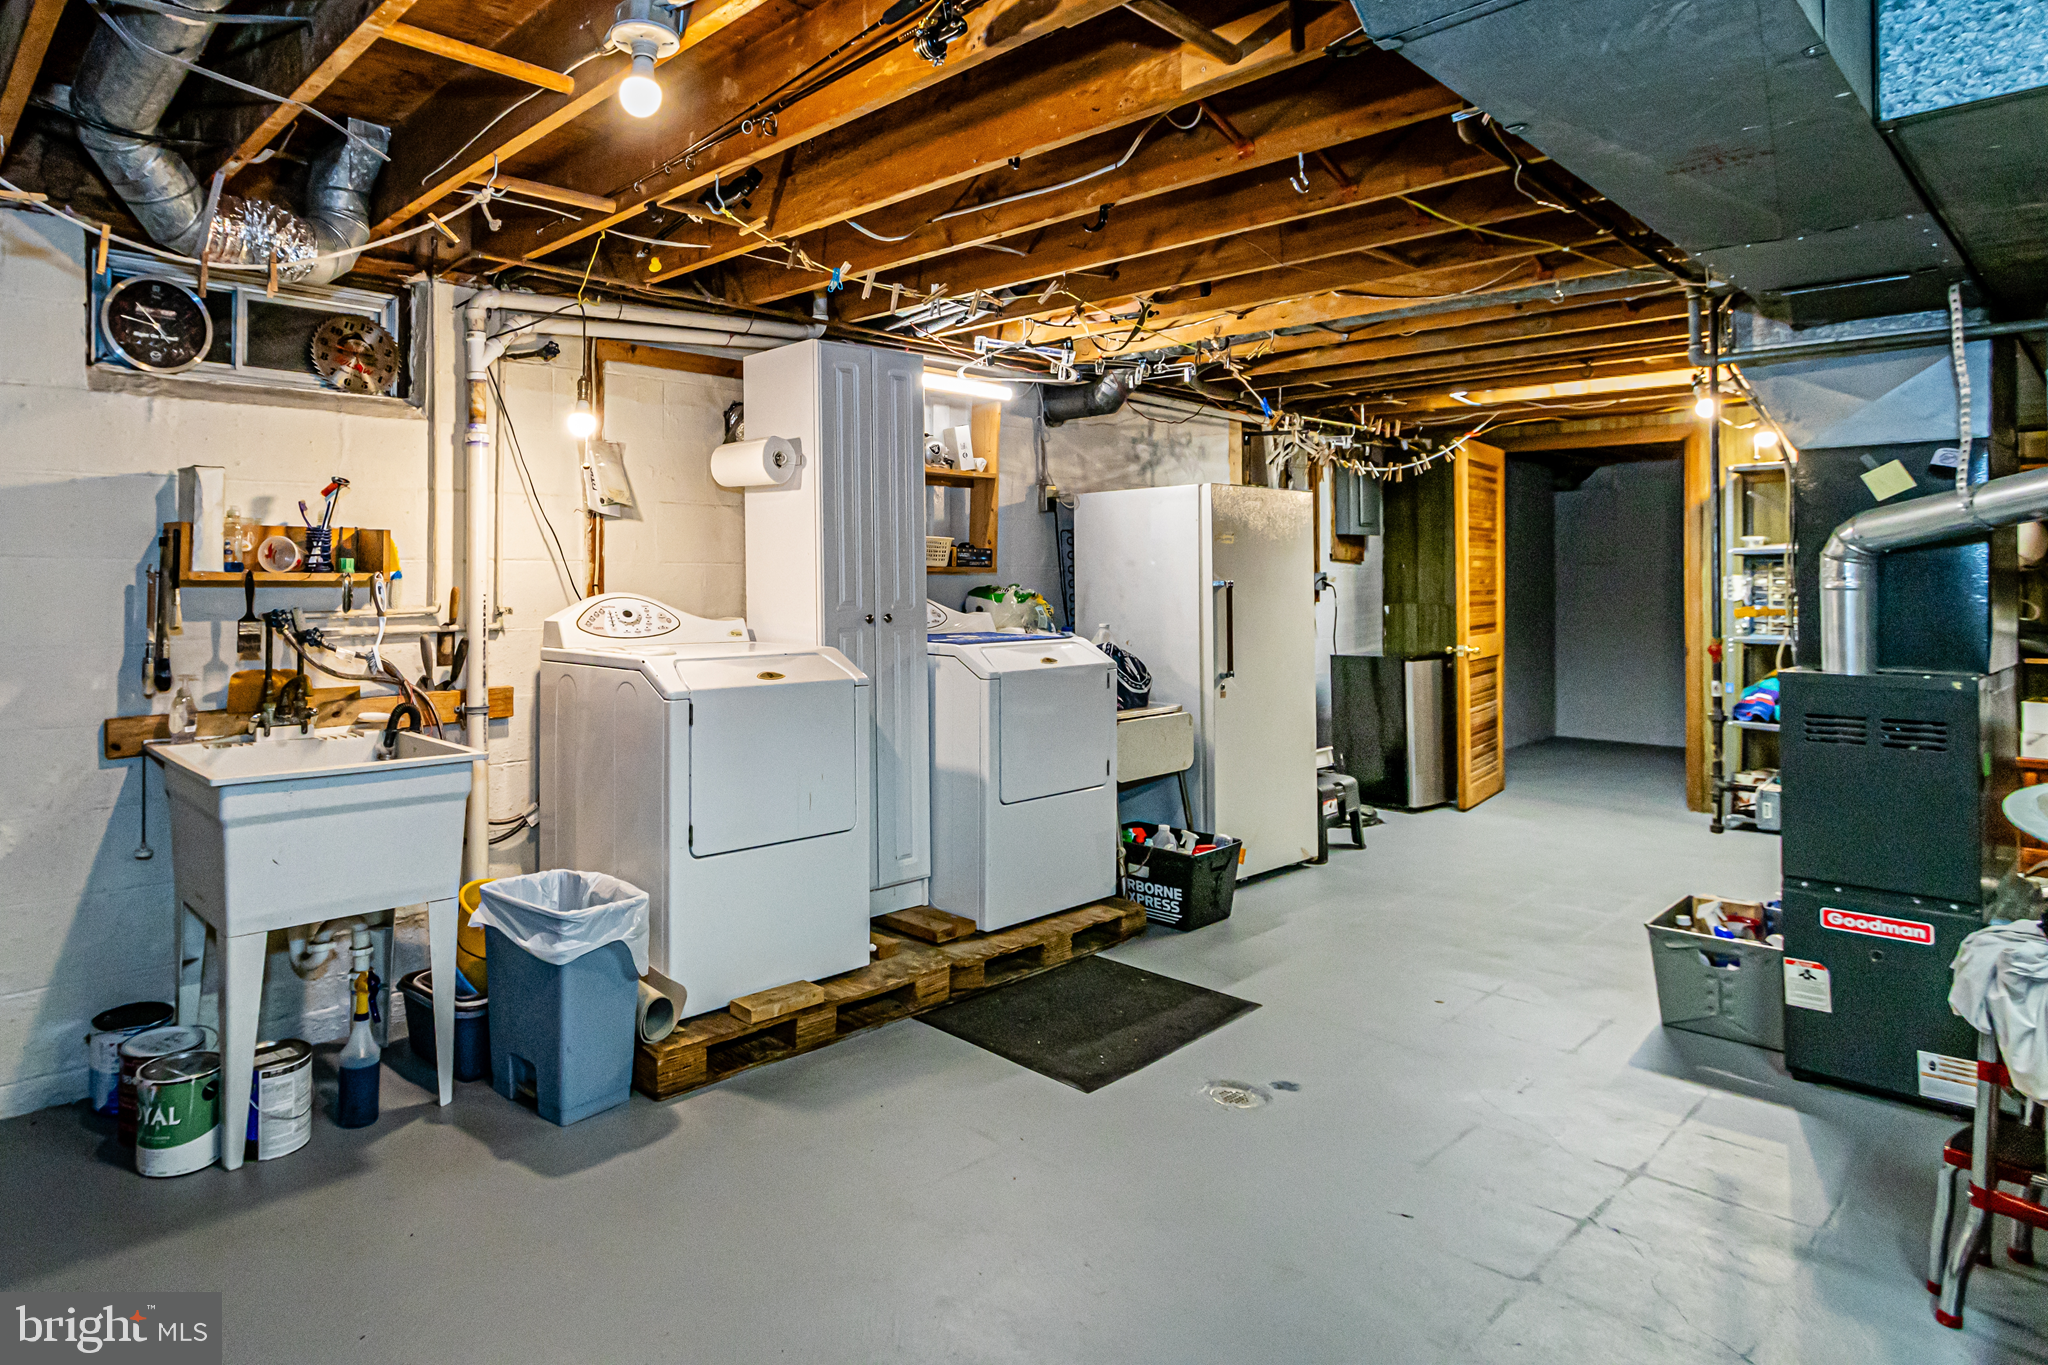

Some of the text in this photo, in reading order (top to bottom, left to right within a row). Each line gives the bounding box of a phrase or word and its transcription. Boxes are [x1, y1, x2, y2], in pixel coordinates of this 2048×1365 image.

[344, 321, 355, 331] 11
[360, 323, 373, 334] 12
[1127, 878, 1183, 901] RBORNE
[1128, 890, 1181, 914] XPRESS
[1827, 912, 1927, 940] Goodman
